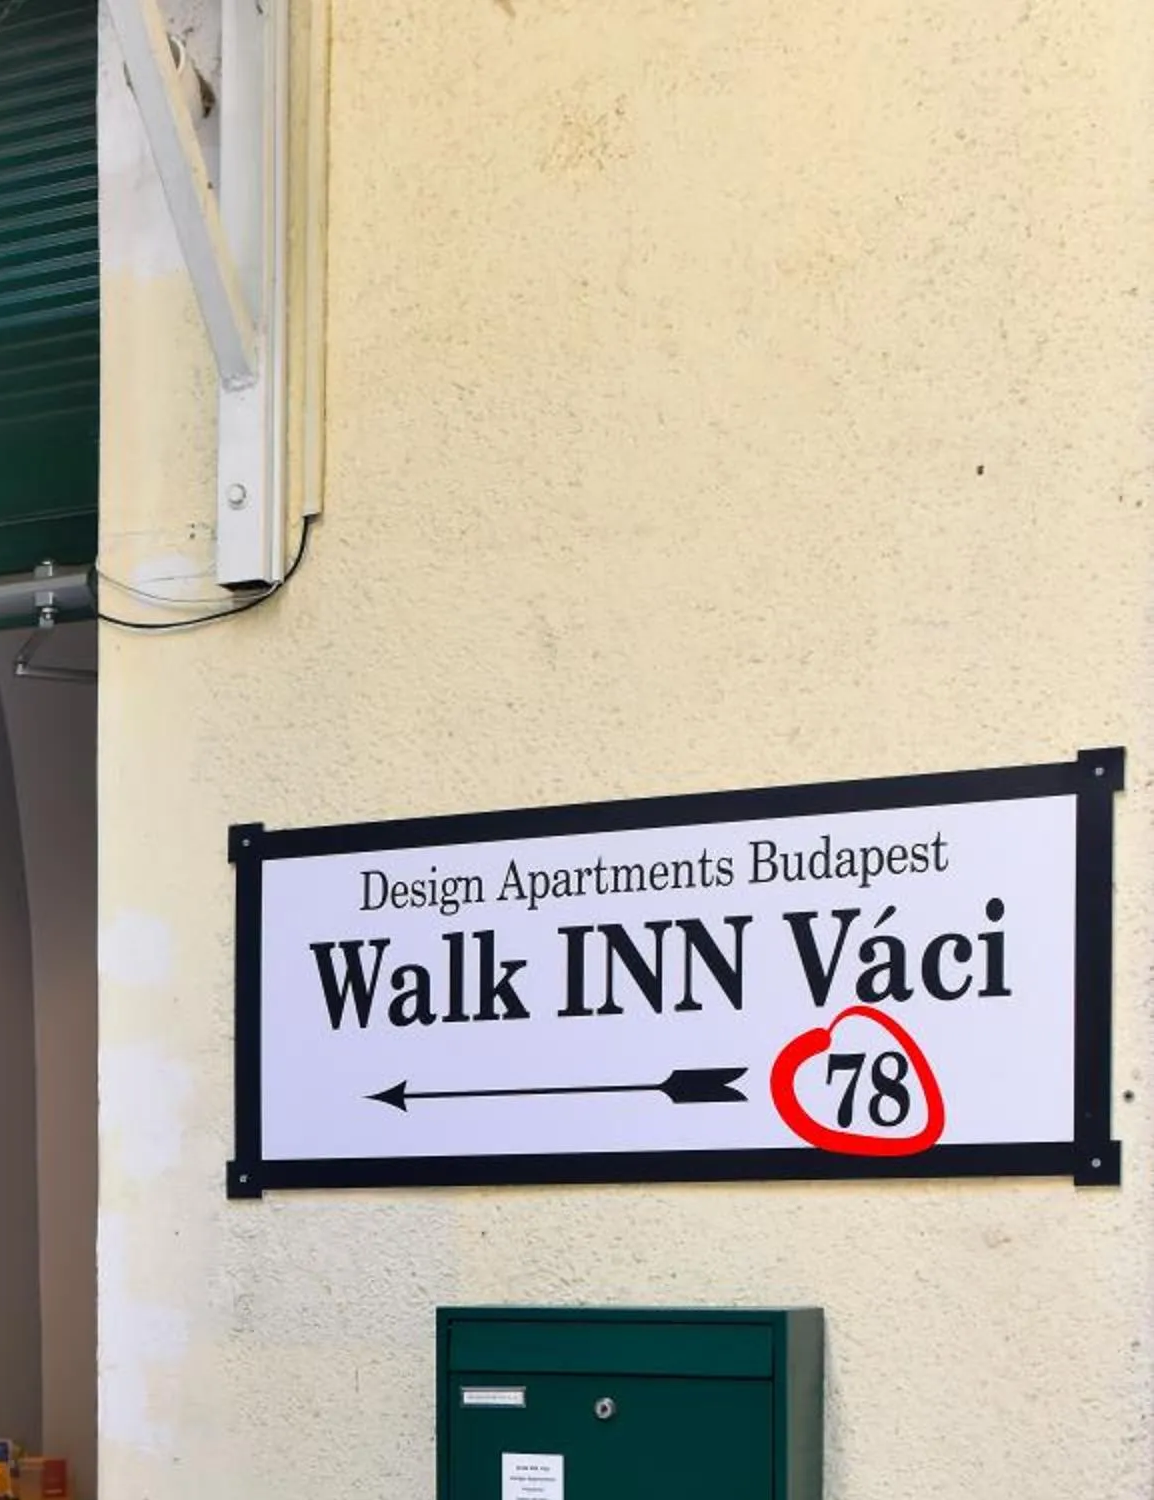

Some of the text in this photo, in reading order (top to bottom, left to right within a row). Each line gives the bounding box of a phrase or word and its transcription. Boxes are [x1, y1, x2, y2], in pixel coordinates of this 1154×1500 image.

[359, 830, 949, 917] Design Apartments Budapest
[309, 896, 1012, 1031] Walk INN Váci
[824, 1050, 911, 1129] 78
